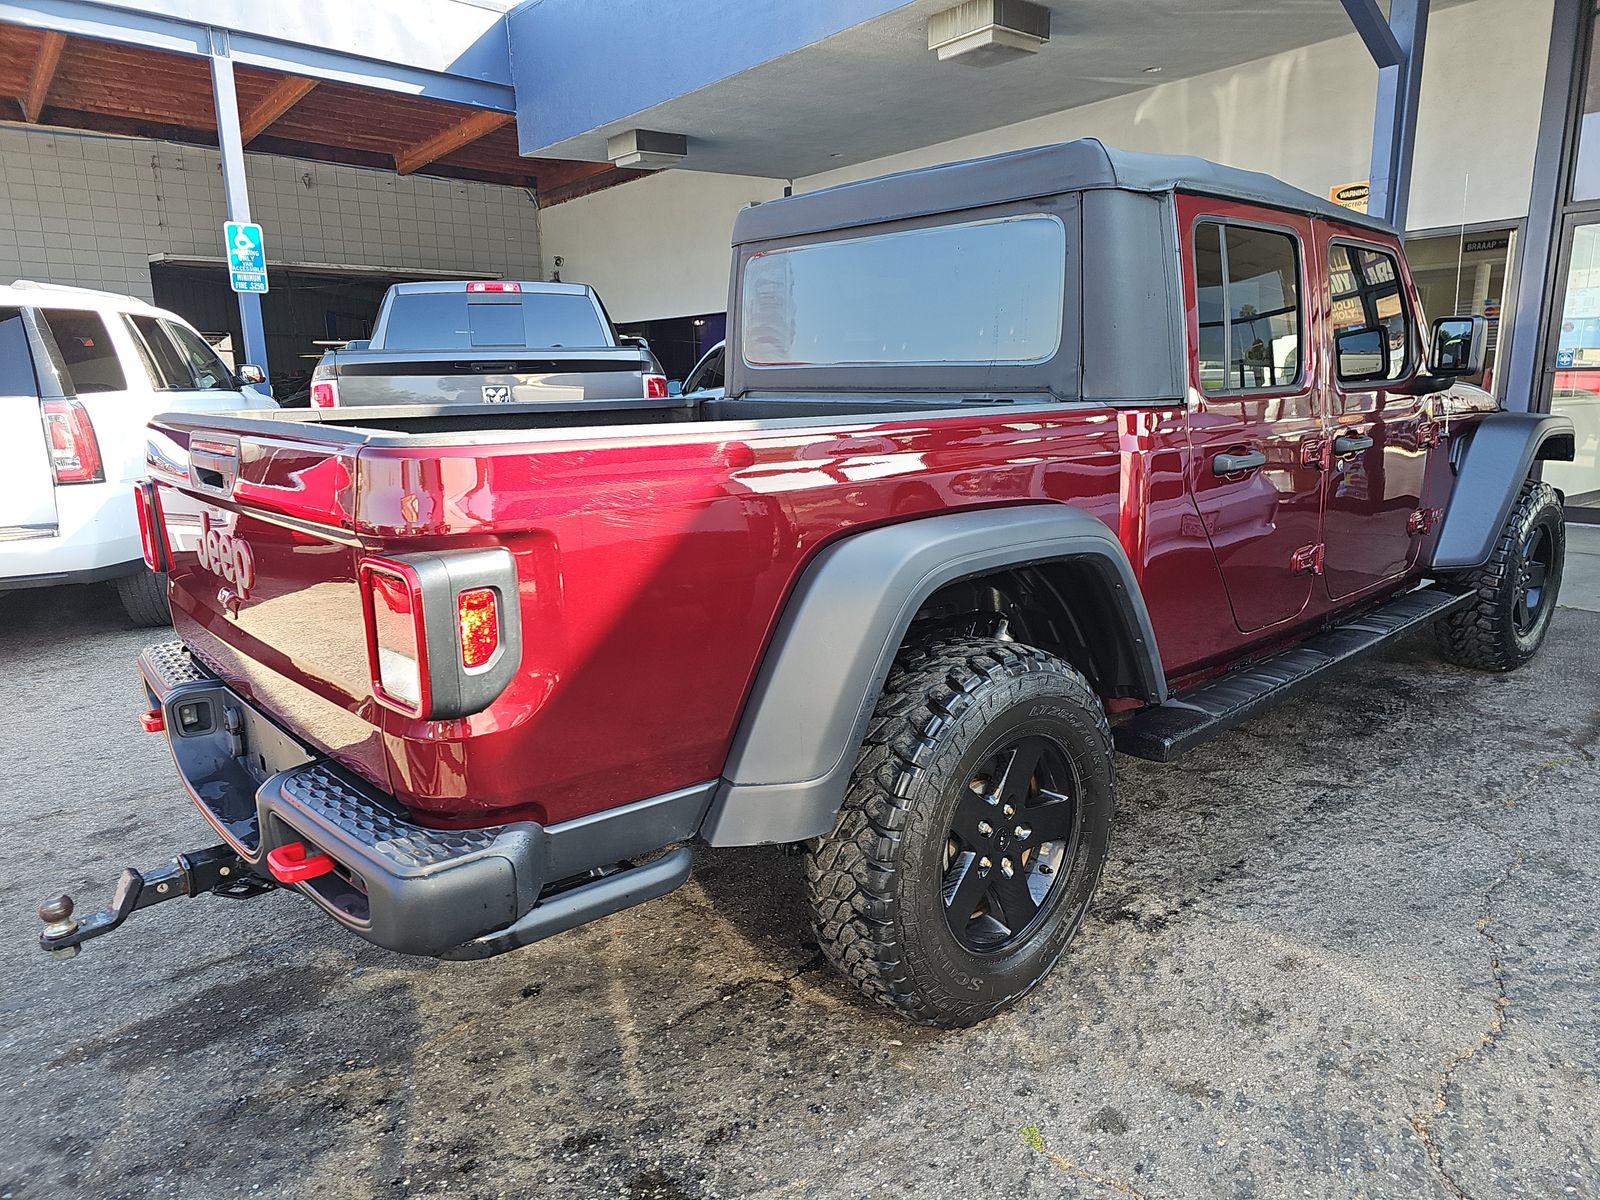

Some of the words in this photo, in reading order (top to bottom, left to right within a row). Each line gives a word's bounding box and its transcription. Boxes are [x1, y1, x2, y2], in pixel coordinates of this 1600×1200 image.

[1340, 188, 1369, 199] WARNING
[236, 274, 261, 282] MINIMUM
[235, 281, 248, 289] FINE
[196, 510, 255, 600] Jeep
